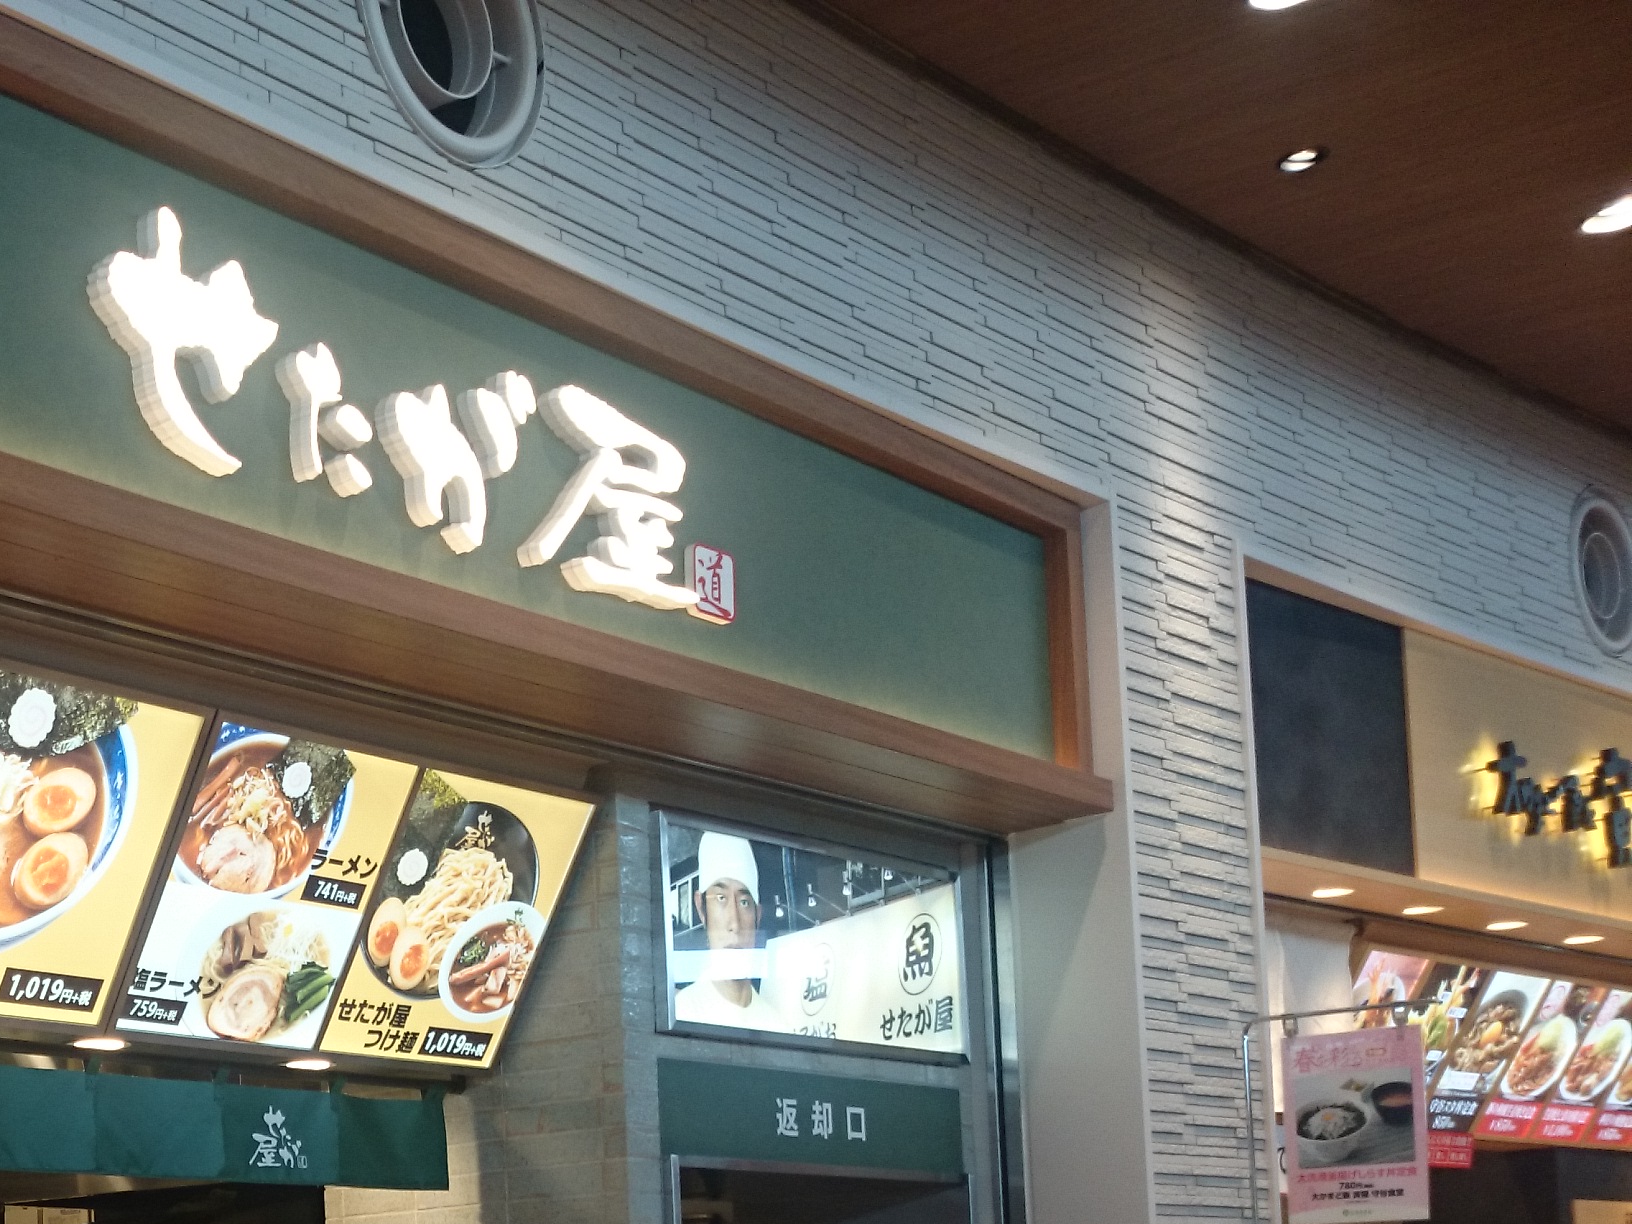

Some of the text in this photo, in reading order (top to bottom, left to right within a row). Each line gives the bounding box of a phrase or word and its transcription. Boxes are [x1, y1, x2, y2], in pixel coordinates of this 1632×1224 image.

[86, 205, 700, 611] せたが屋
[311, 847, 378, 879] ラーメン
[313, 880, 358, 905] 741円+税
[7, 972, 95, 1009] 1,019円+税
[131, 965, 222, 1000] 塩ラーメン
[128, 999, 179, 1023] 759円+税
[336, 997, 413, 1030] せたが屋
[879, 994, 954, 1042] せたが屋
[363, 1028, 487, 1060] つけ麺 1,019円+税
[775, 1096, 867, 1142] 返却口
